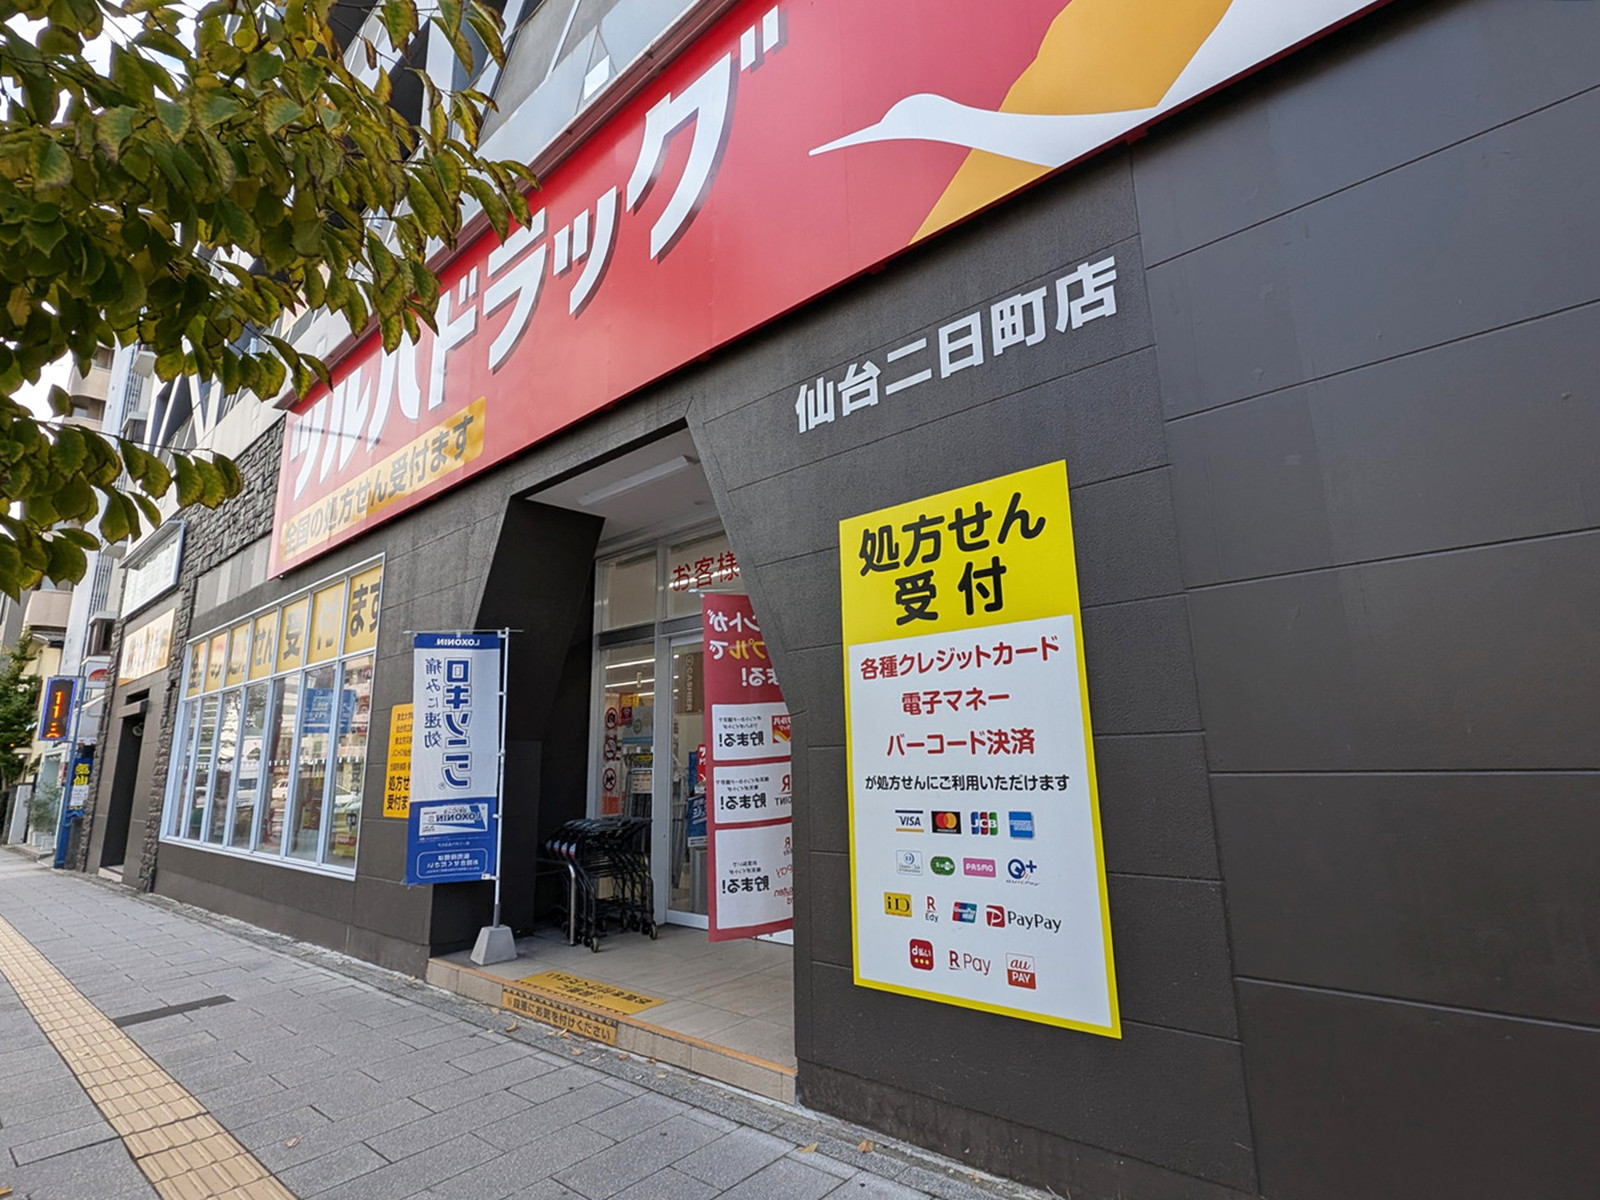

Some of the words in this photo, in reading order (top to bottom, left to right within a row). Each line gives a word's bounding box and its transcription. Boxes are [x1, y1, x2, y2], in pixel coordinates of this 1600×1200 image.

[795, 256, 1117, 433] 仙台二日町店
[283, 414, 474, 556] 全国の処方せん受付ます
[859, 492, 1046, 577] 処方せん
[672, 551, 740, 592] お客様
[861, 636, 1059, 680] 各種クレジットカード
[902, 687, 1010, 716] 電子マネー
[887, 728, 1035, 756] バーコード決済
[865, 774, 1070, 791] が処方せんにご利用いただけます
[899, 815, 921, 827] VISA
[971, 819, 997, 828] JCB
[965, 862, 994, 873] PASMO
[886, 896, 910, 913] iD
[925, 912, 939, 923] Edy
[1008, 910, 1062, 933] PayPay
[963, 953, 991, 975] Pay
[1010, 958, 1031, 970] au
[1011, 973, 1031, 983] PAY
